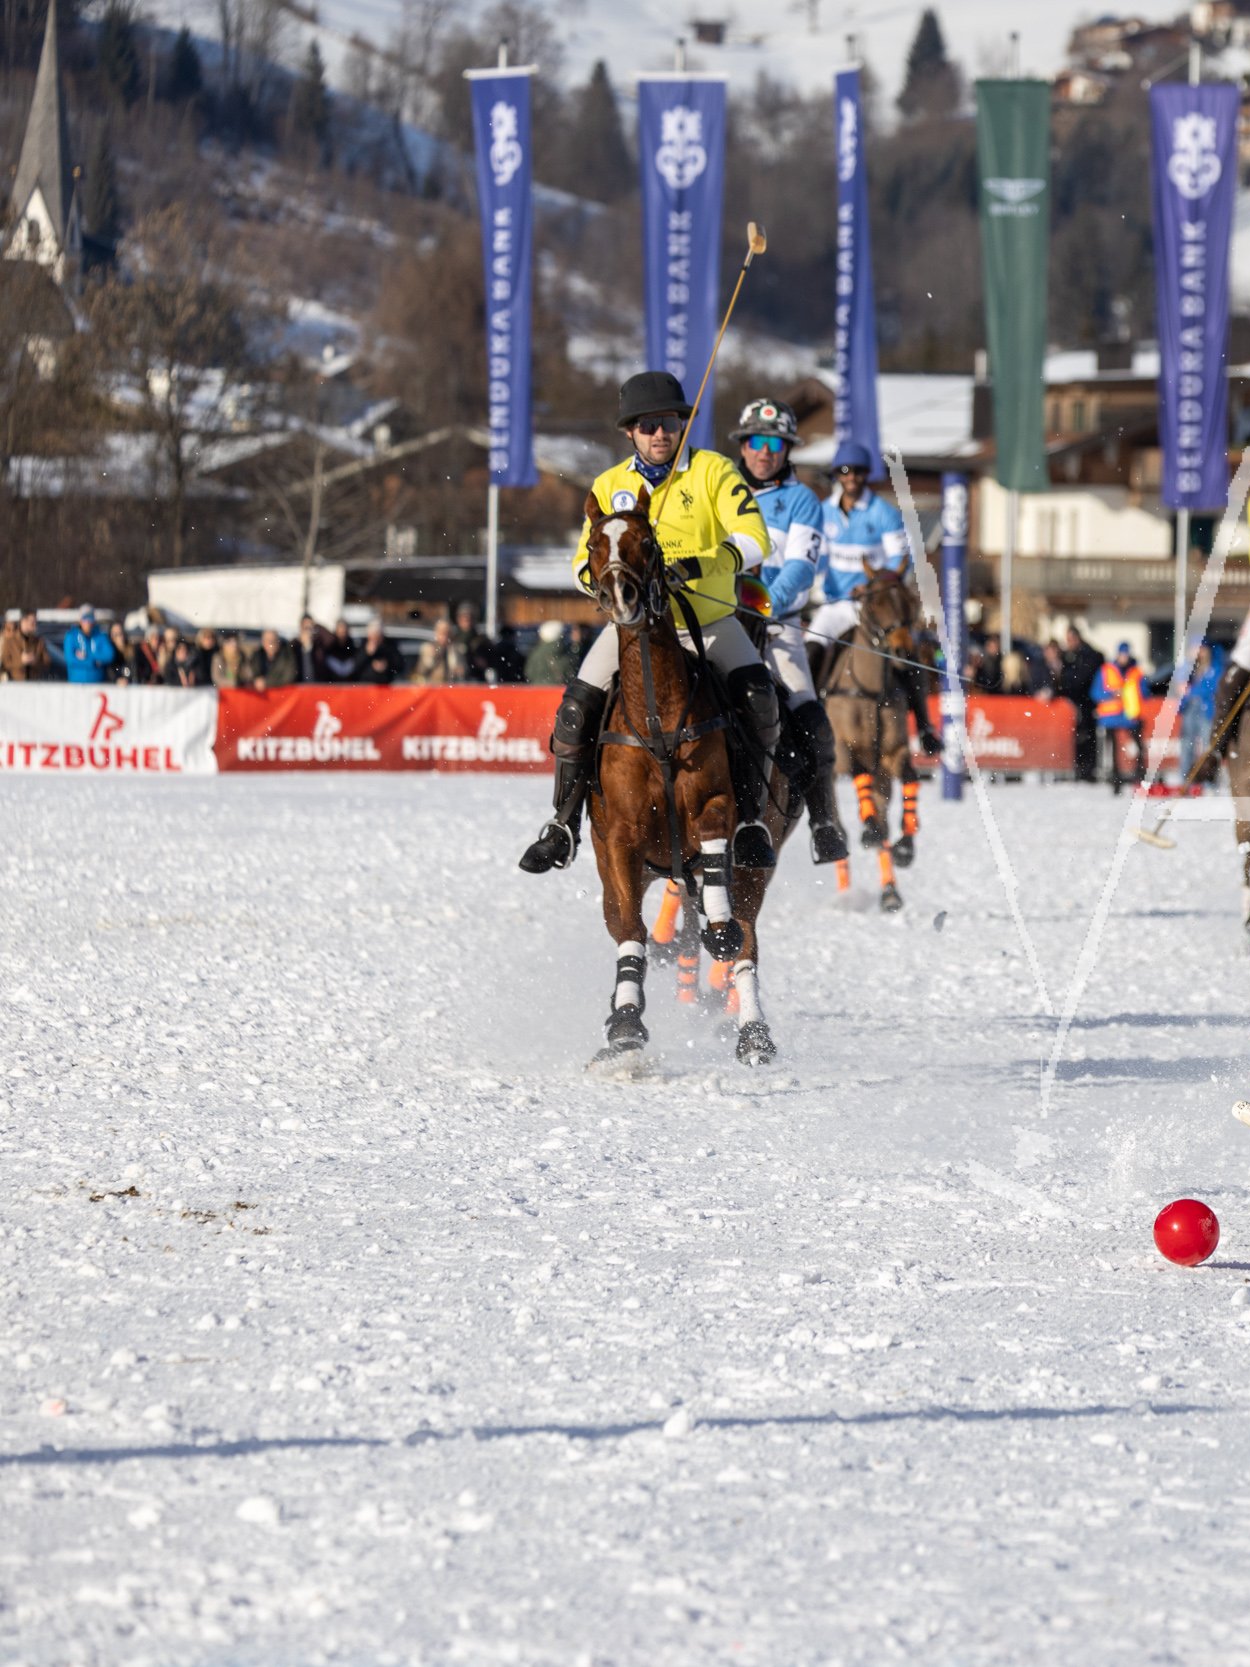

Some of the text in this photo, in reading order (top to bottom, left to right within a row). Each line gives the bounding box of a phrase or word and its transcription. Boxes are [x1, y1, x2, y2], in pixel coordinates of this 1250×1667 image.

[492, 207, 512, 300] BANK
[667, 211, 692, 304] BANK
[1178, 221, 1206, 492] BENDURA BANK
[731, 483, 758, 516] 2
